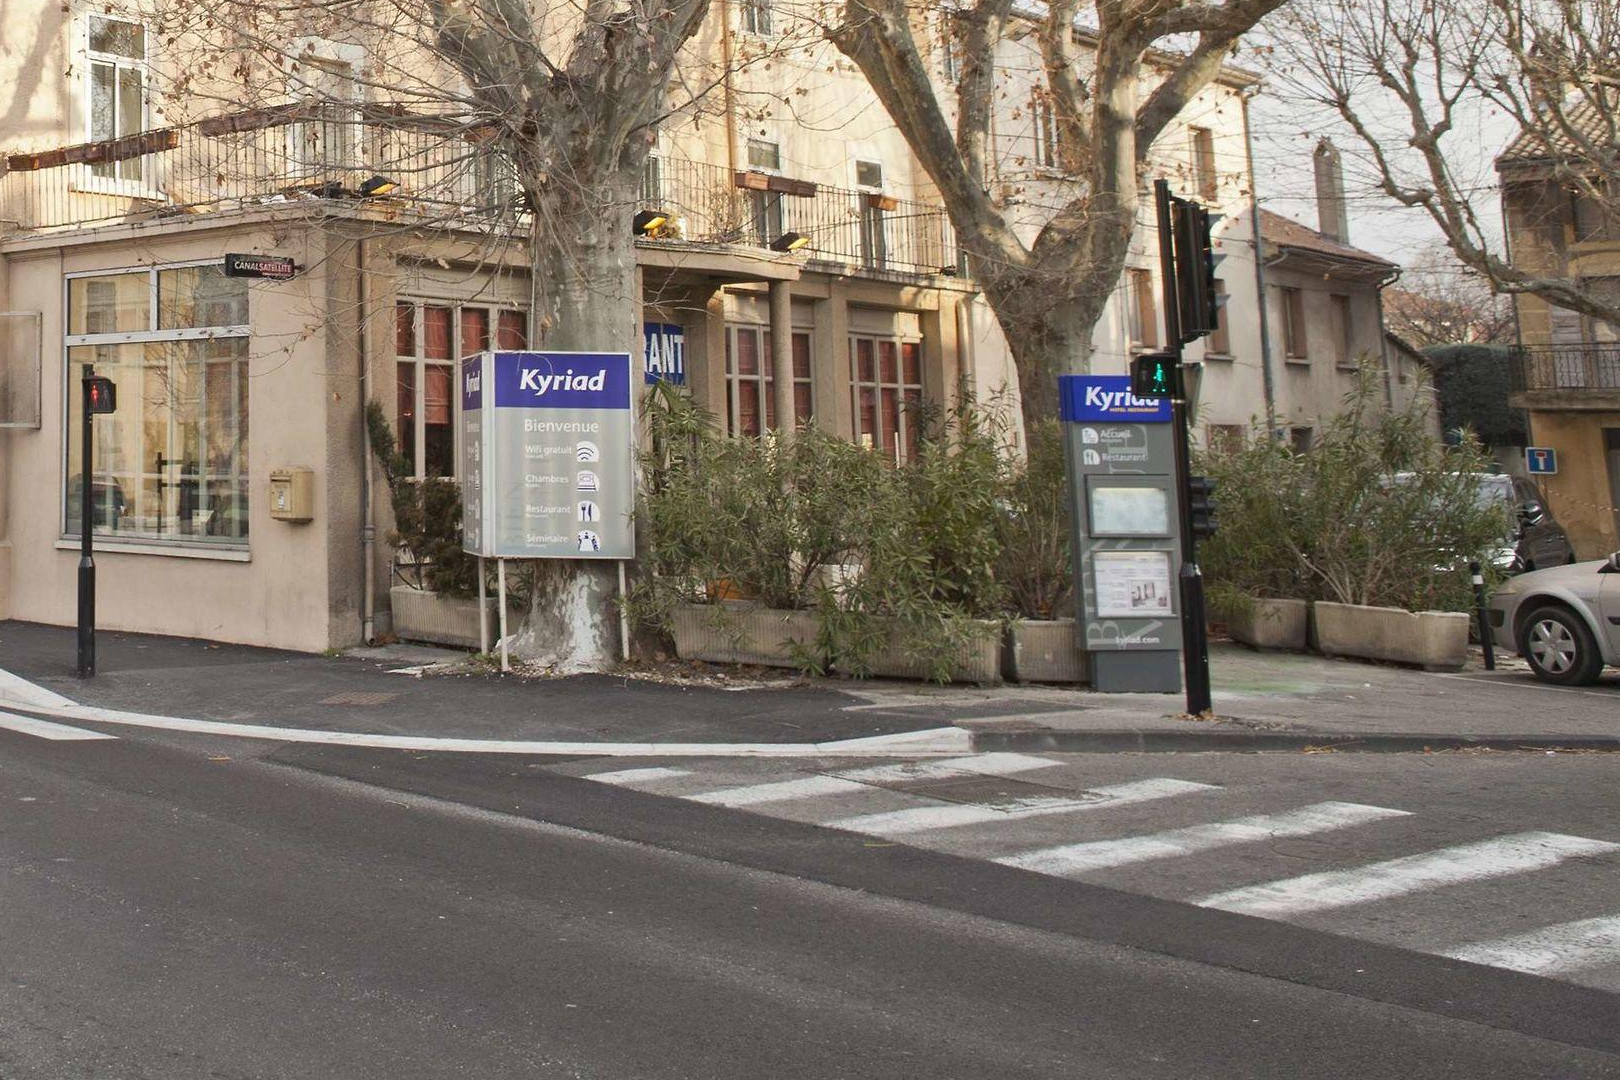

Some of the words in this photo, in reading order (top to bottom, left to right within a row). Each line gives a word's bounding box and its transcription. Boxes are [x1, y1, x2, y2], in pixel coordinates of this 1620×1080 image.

[644, 333, 684, 373] ANT
[519, 368, 607, 396] Kyriad
[524, 419, 600, 433] Bienvenue
[525, 444, 541, 454] Wifi
[543, 445, 572, 457] gratuit
[525, 474, 569, 484] Chambres
[525, 504, 571, 514] Restaurant
